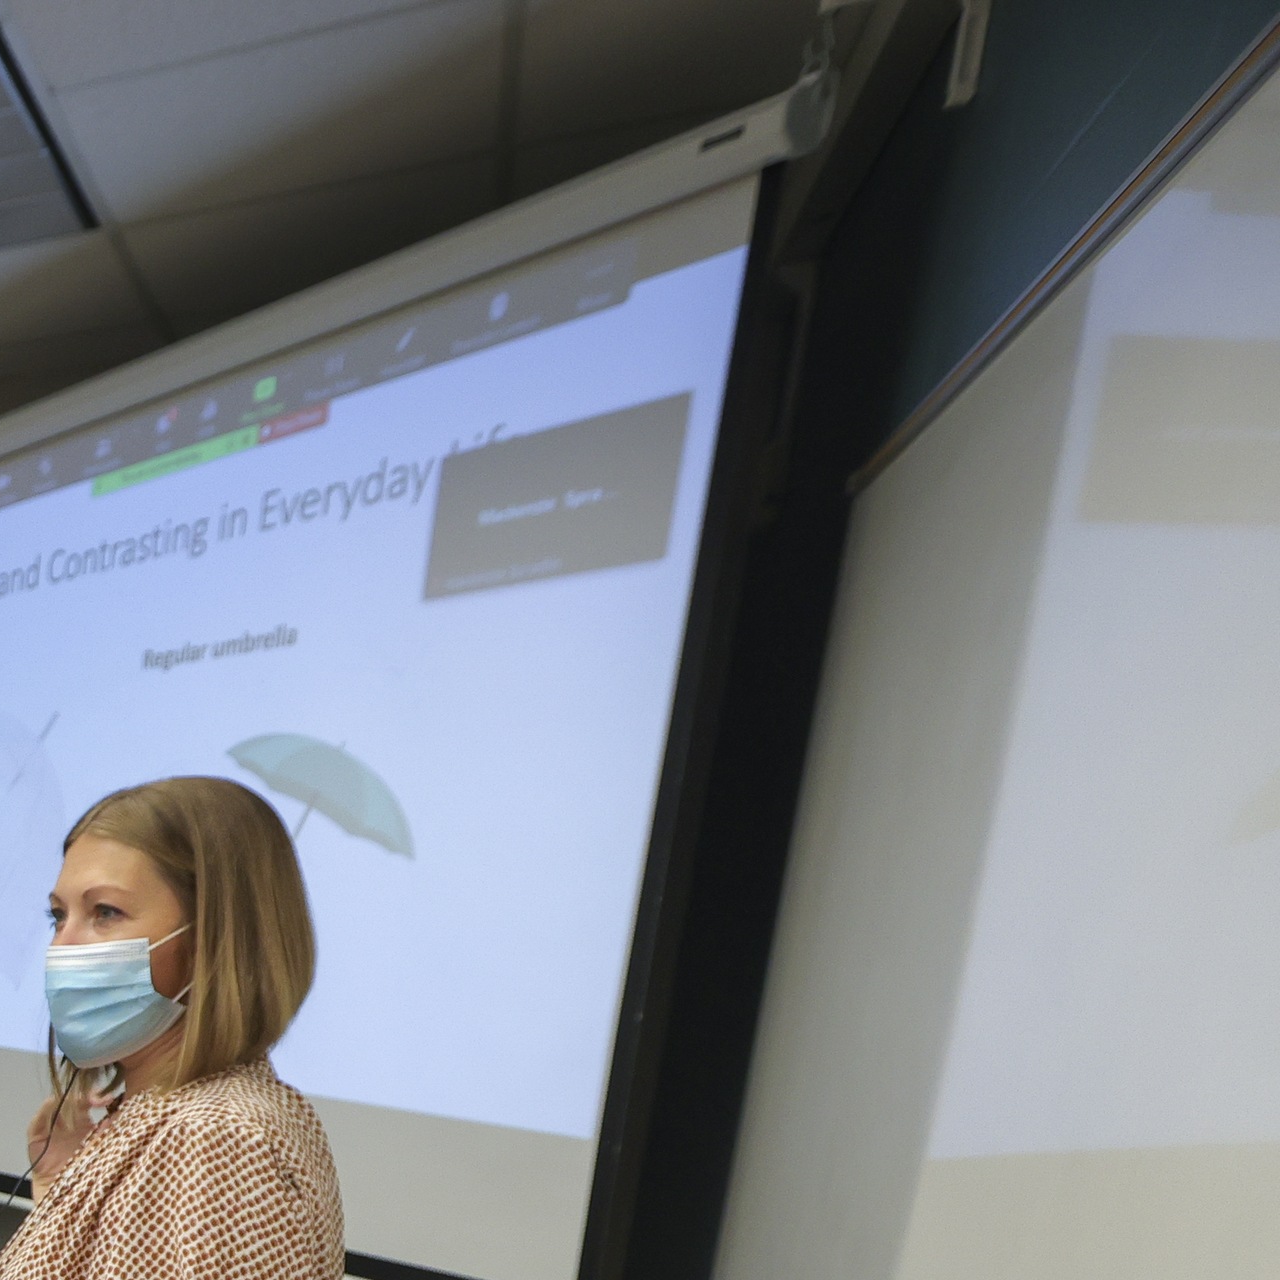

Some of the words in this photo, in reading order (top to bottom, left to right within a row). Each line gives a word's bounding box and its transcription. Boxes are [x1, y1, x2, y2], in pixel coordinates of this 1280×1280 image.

[47, 511, 210, 586] Contrasting
[217, 502, 248, 542] in
[259, 456, 435, 533] Everyday
[143, 642, 208, 673] Regular
[211, 623, 299, 659] umbrella
